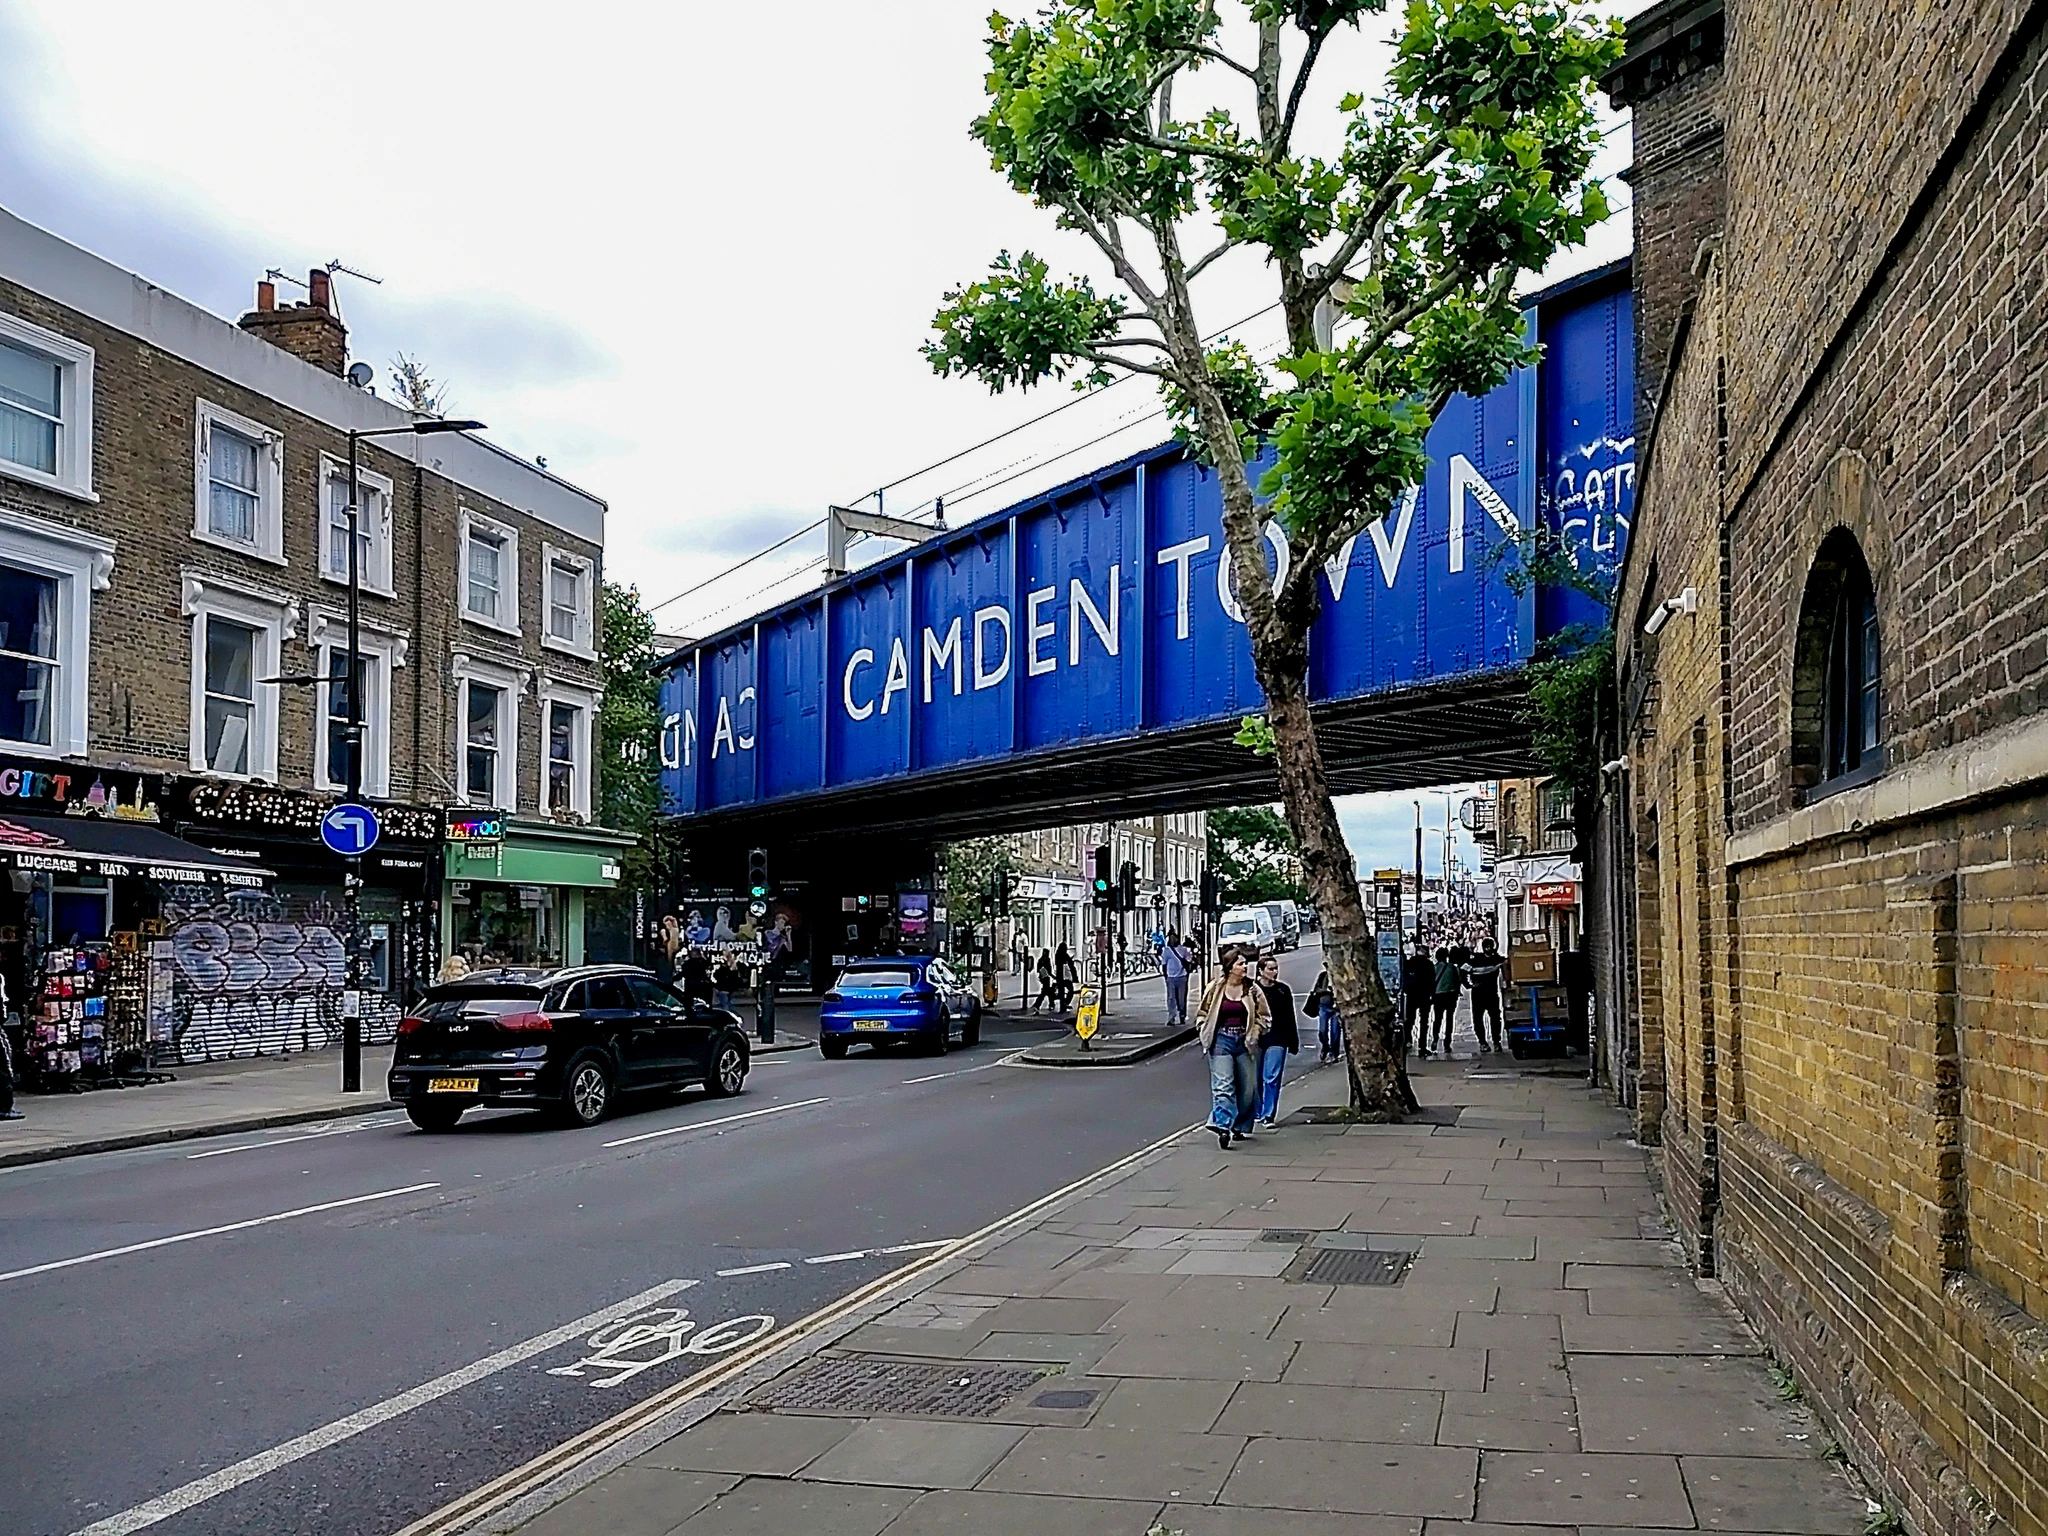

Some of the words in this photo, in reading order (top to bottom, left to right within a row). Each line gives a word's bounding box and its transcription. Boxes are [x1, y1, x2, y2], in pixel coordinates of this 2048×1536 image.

[843, 564, 1120, 722] CAMDEN
[0, 768, 71, 801] GIFT
[17, 854, 77, 872] LUGGAGE
